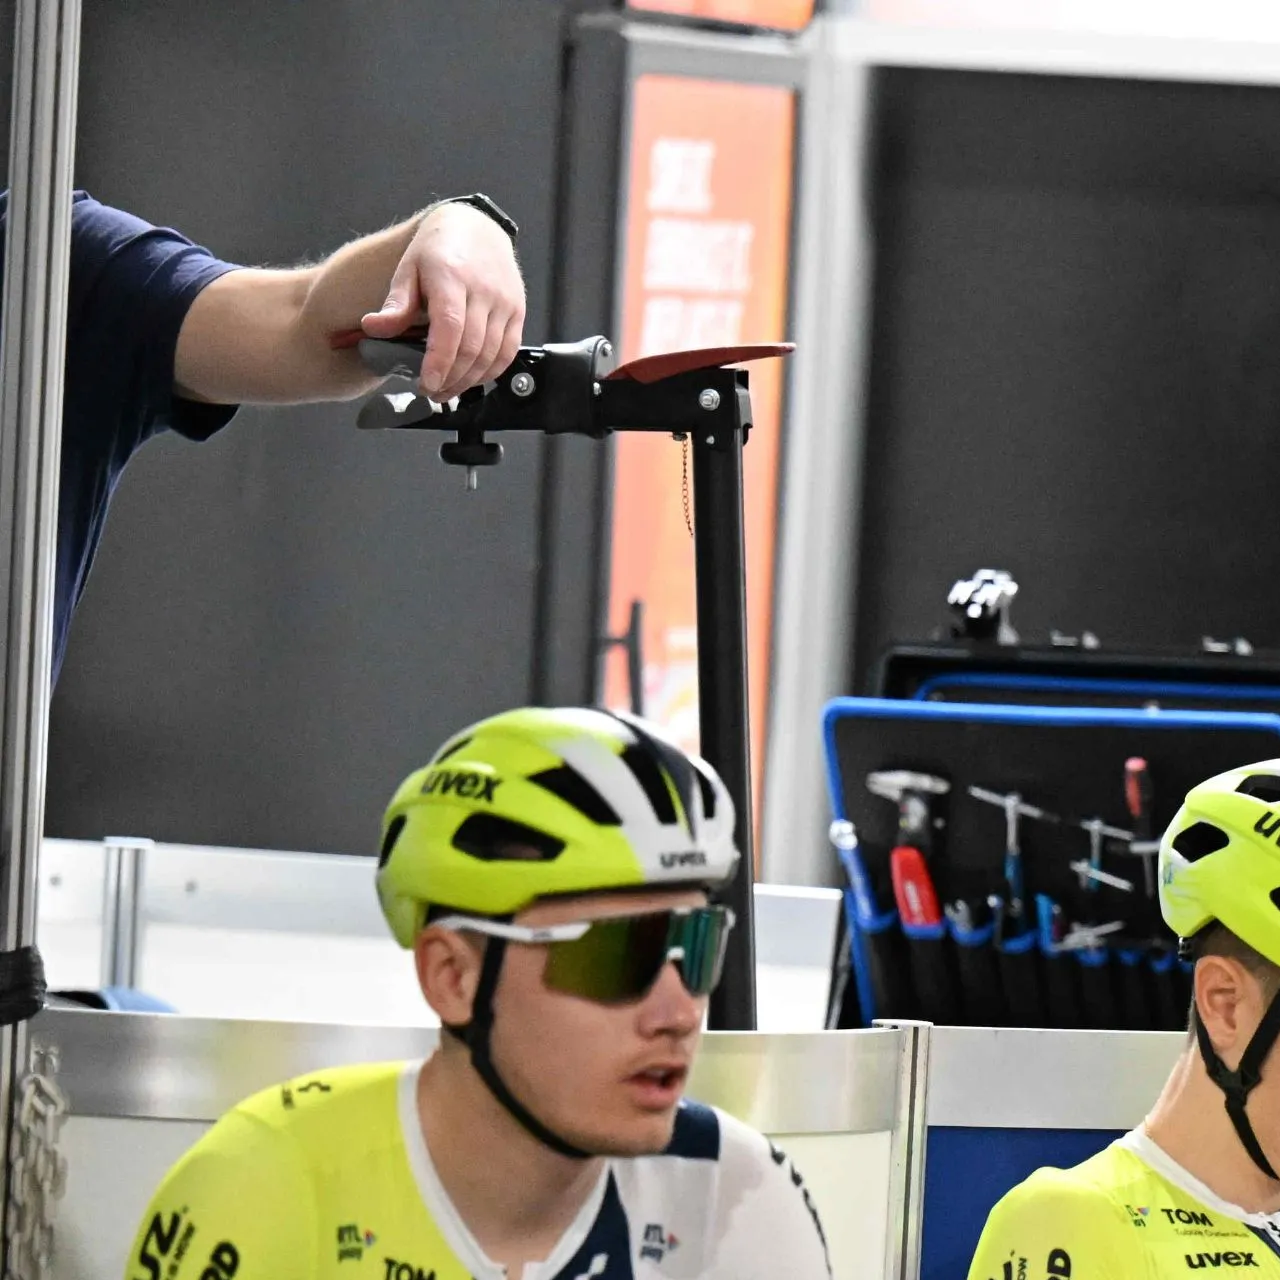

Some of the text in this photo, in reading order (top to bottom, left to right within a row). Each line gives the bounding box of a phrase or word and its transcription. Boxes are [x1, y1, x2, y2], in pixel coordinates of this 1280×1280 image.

[420, 769, 505, 802] uvex
[1160, 1208, 1214, 1228] TOM
[1184, 1250, 1260, 1270] uvex
